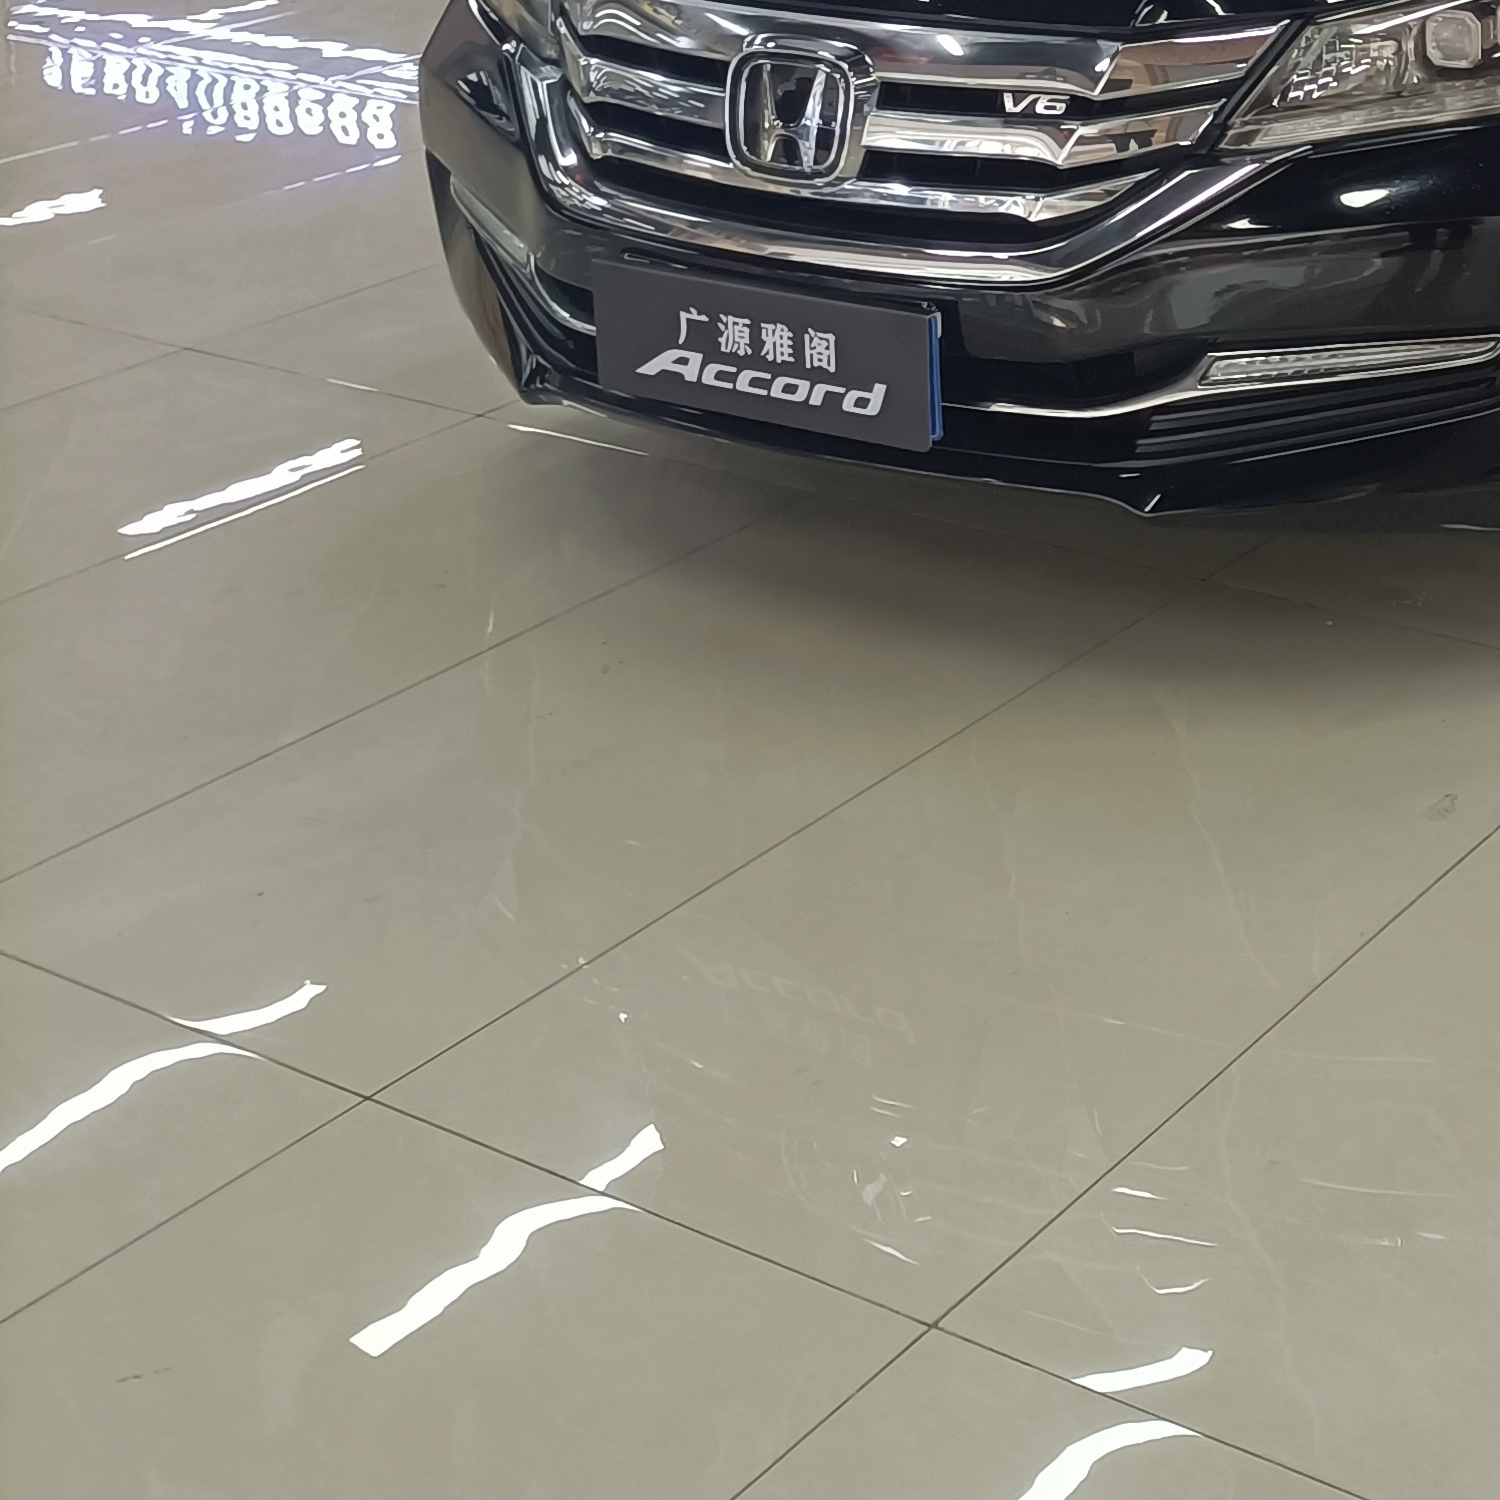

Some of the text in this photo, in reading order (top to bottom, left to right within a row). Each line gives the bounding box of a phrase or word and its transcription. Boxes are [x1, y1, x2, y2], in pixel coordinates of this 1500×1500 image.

[1002, 91, 1071, 117] V6
[676, 307, 838, 374] 广源雅阁
[636, 347, 887, 417] Accord
